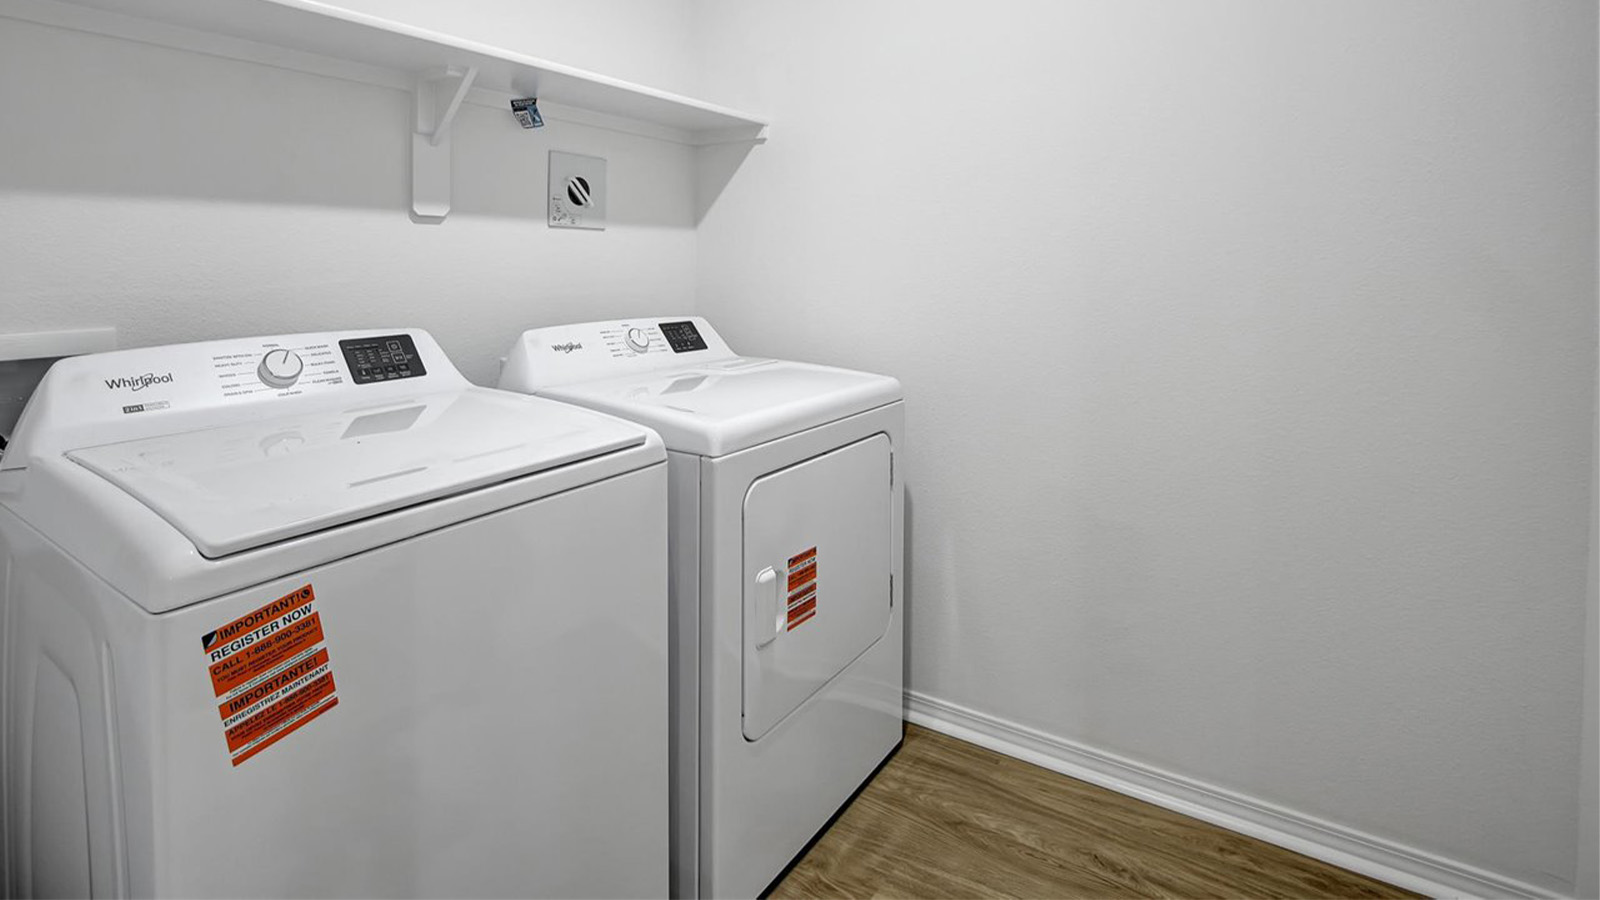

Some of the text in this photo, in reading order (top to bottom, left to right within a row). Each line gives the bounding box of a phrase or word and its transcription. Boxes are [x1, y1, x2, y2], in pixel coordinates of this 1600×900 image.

[551, 341, 583, 354] Whirlpool
[105, 372, 173, 392] Whirlpool
[210, 620, 280, 662] REGISTER
[282, 603, 313, 626] NOW
[212, 656, 241, 675] CALL
[245, 616, 316, 659] 1-888-900-3381
[228, 655, 318, 713] IMPORTANTE!
[281, 663, 328, 695] MAINTENANT
